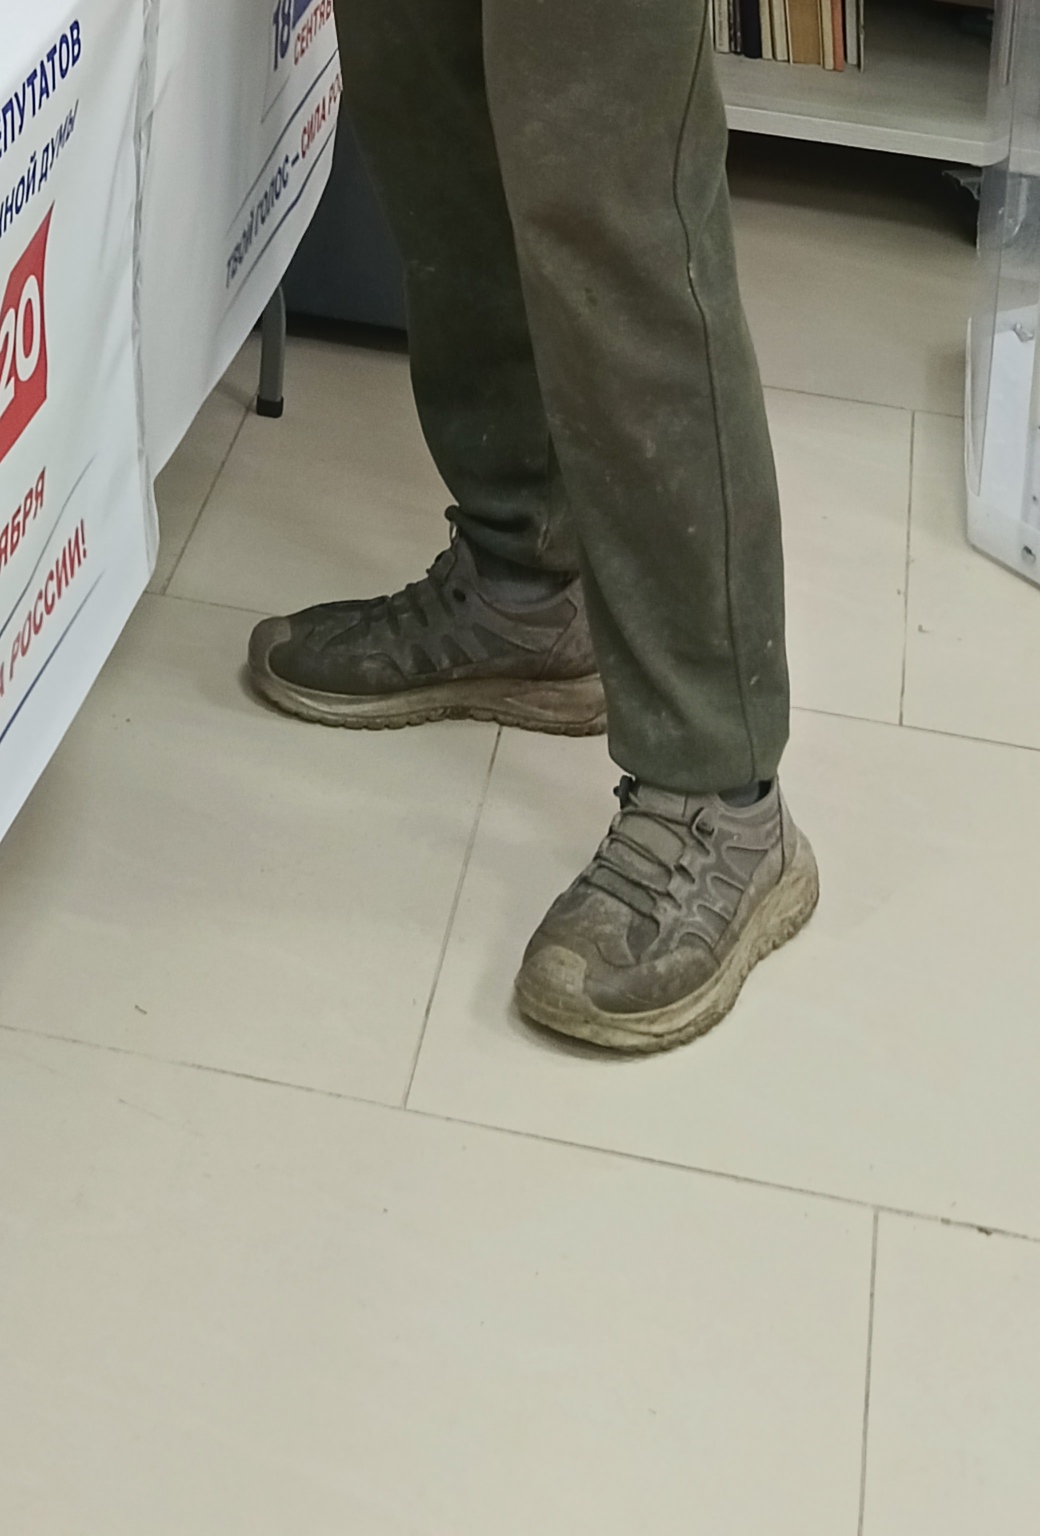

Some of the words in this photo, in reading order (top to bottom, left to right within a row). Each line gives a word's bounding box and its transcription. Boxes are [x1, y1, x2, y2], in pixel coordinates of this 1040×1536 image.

[37, 98, 80, 192] ДУМЫ
[254, 154, 290, 236] ГОЛОС
[300, 95, 327, 160] СИЛА
[8, 518, 88, 683] РОССИИ!
